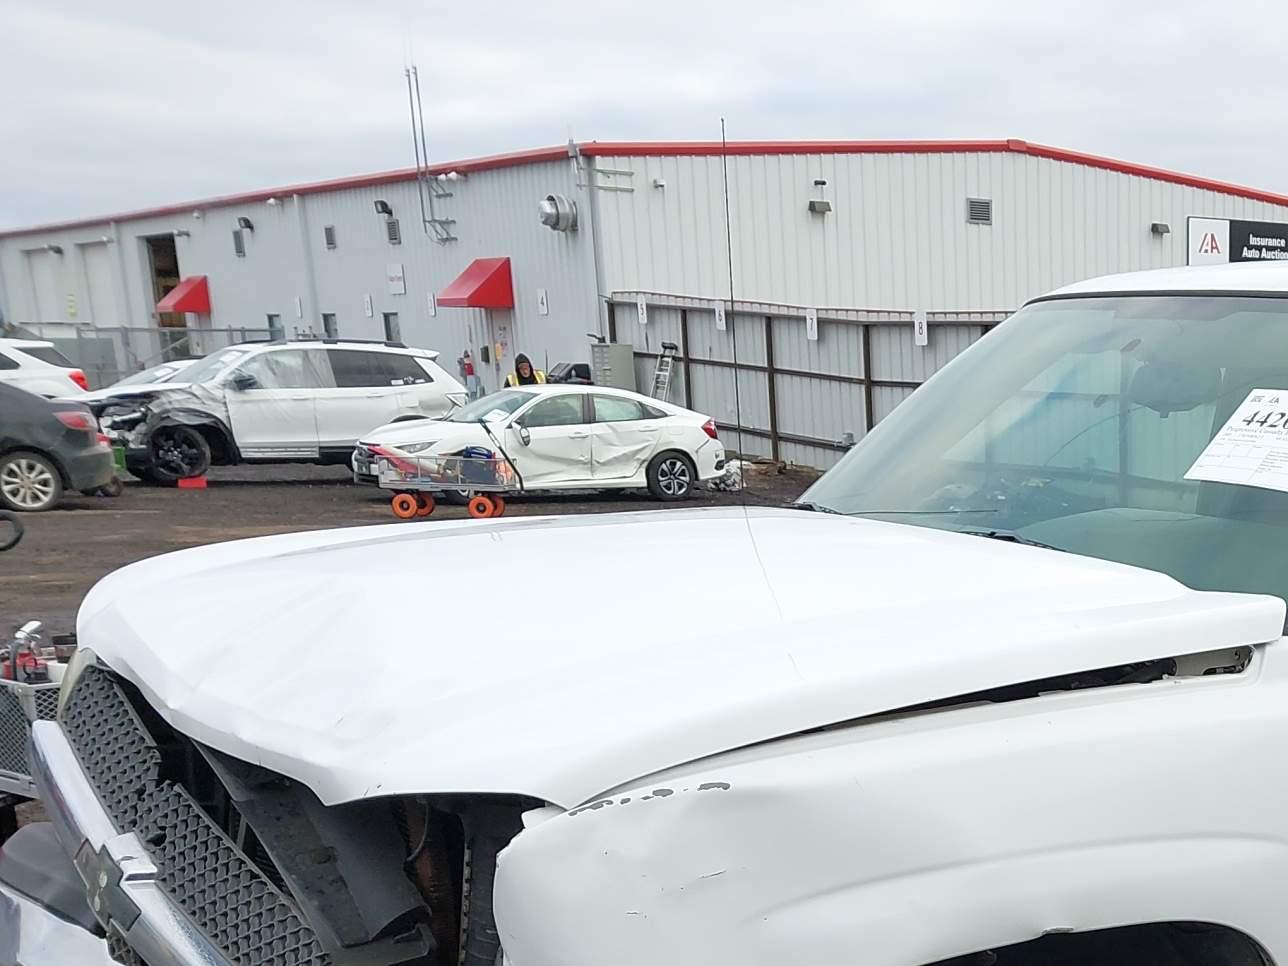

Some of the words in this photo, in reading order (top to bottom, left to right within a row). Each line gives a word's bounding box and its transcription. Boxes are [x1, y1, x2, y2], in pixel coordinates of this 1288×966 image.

[1249, 233, 1286, 247] Insurance
[1241, 246, 1261, 259] Auto
[918, 321, 924, 335] 8
